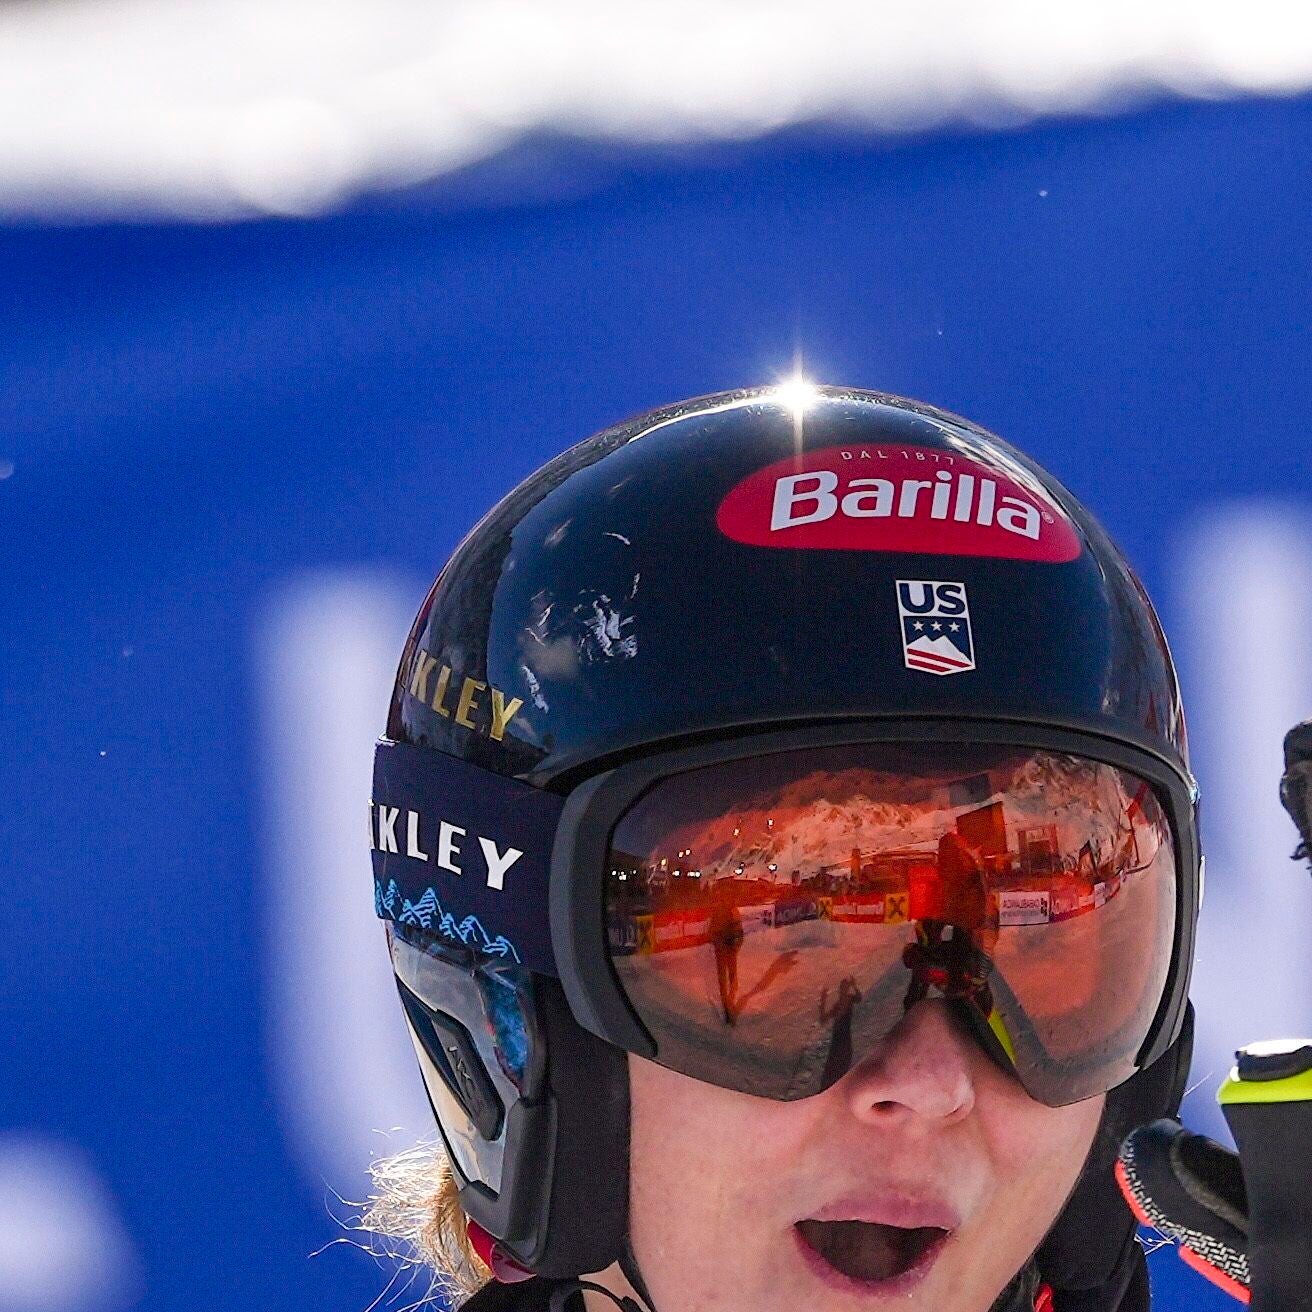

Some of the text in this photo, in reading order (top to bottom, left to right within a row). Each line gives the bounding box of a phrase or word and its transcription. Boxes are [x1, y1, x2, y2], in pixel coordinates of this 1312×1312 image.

[841, 450, 955, 465] DAL 1877
[770, 470, 1040, 540] Barilla
[899, 582, 966, 615] US
[404, 649, 524, 742] KLEY
[368, 800, 524, 891] KLEY
